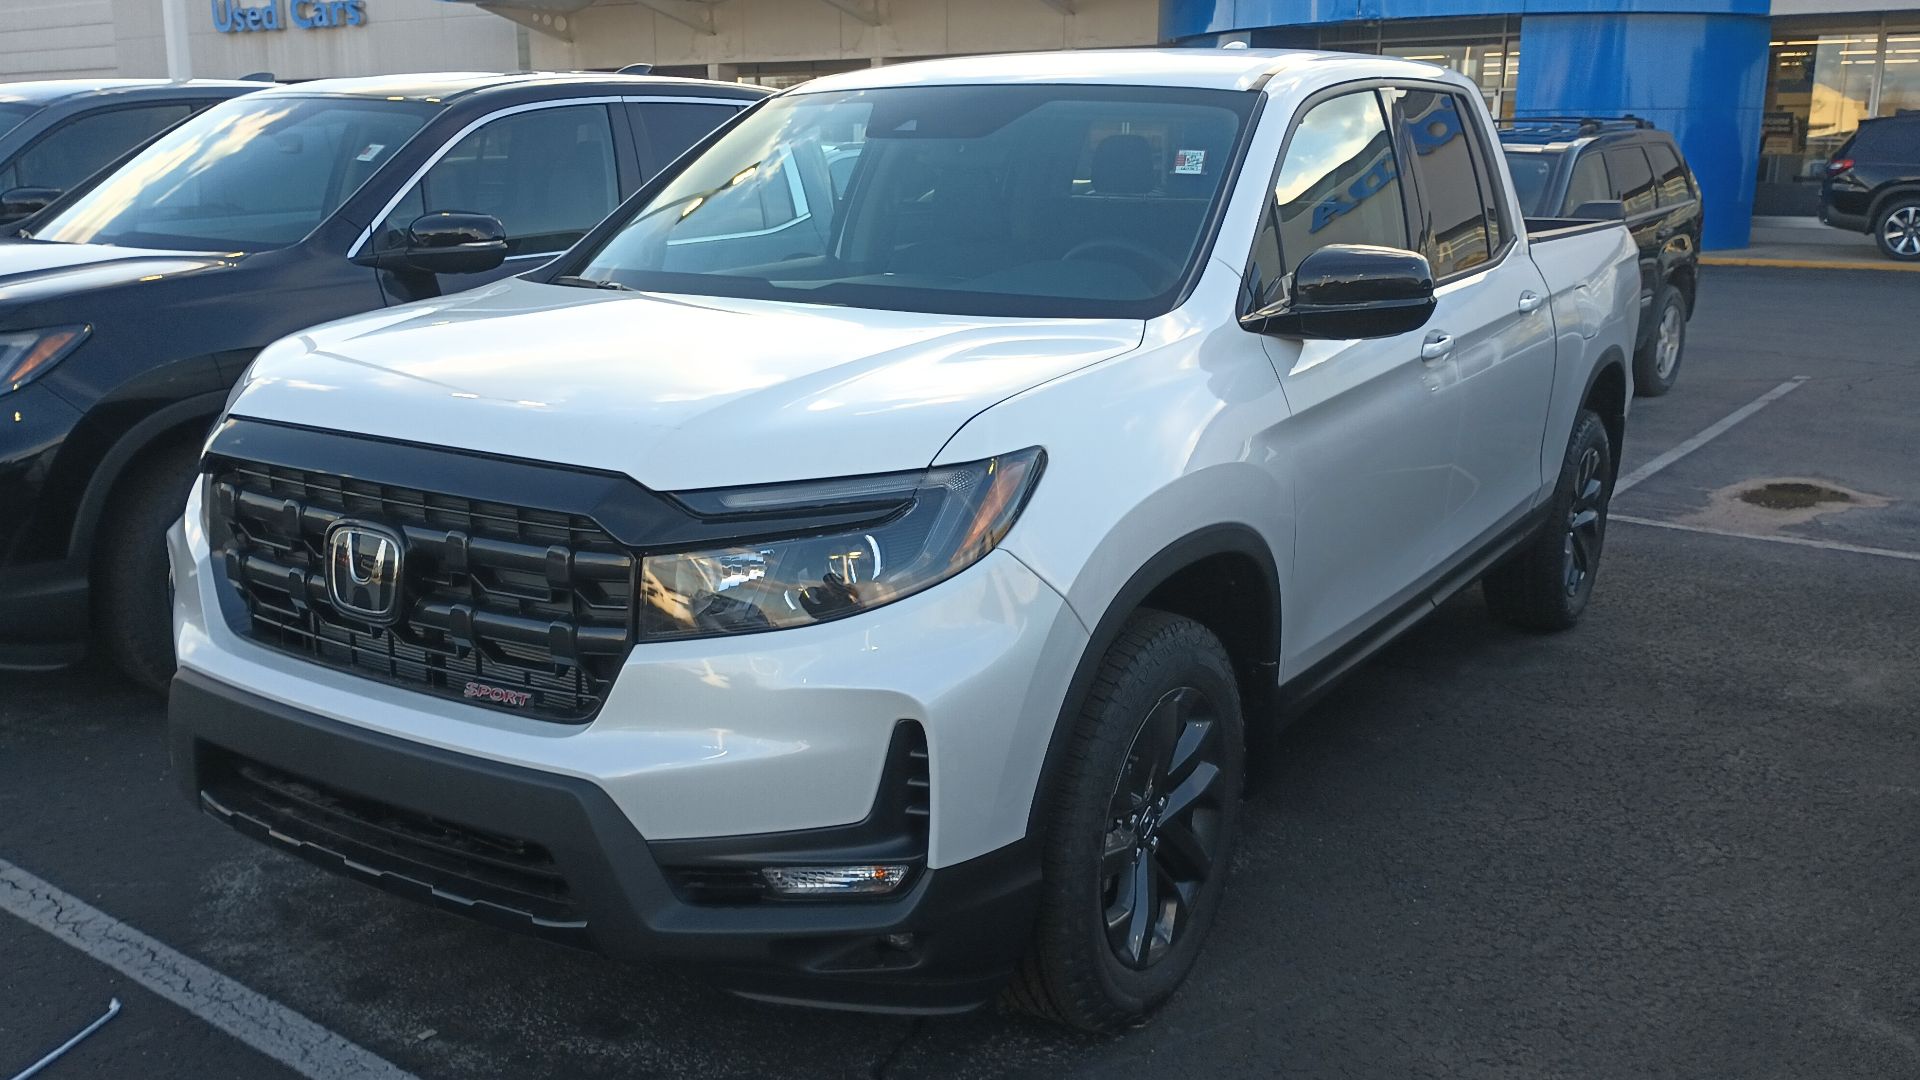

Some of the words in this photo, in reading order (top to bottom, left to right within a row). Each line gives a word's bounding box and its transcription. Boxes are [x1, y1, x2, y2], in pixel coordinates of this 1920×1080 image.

[211, 0, 283, 33] Used
[290, 0, 365, 29] Cars
[464, 681, 531, 706] SPORT
